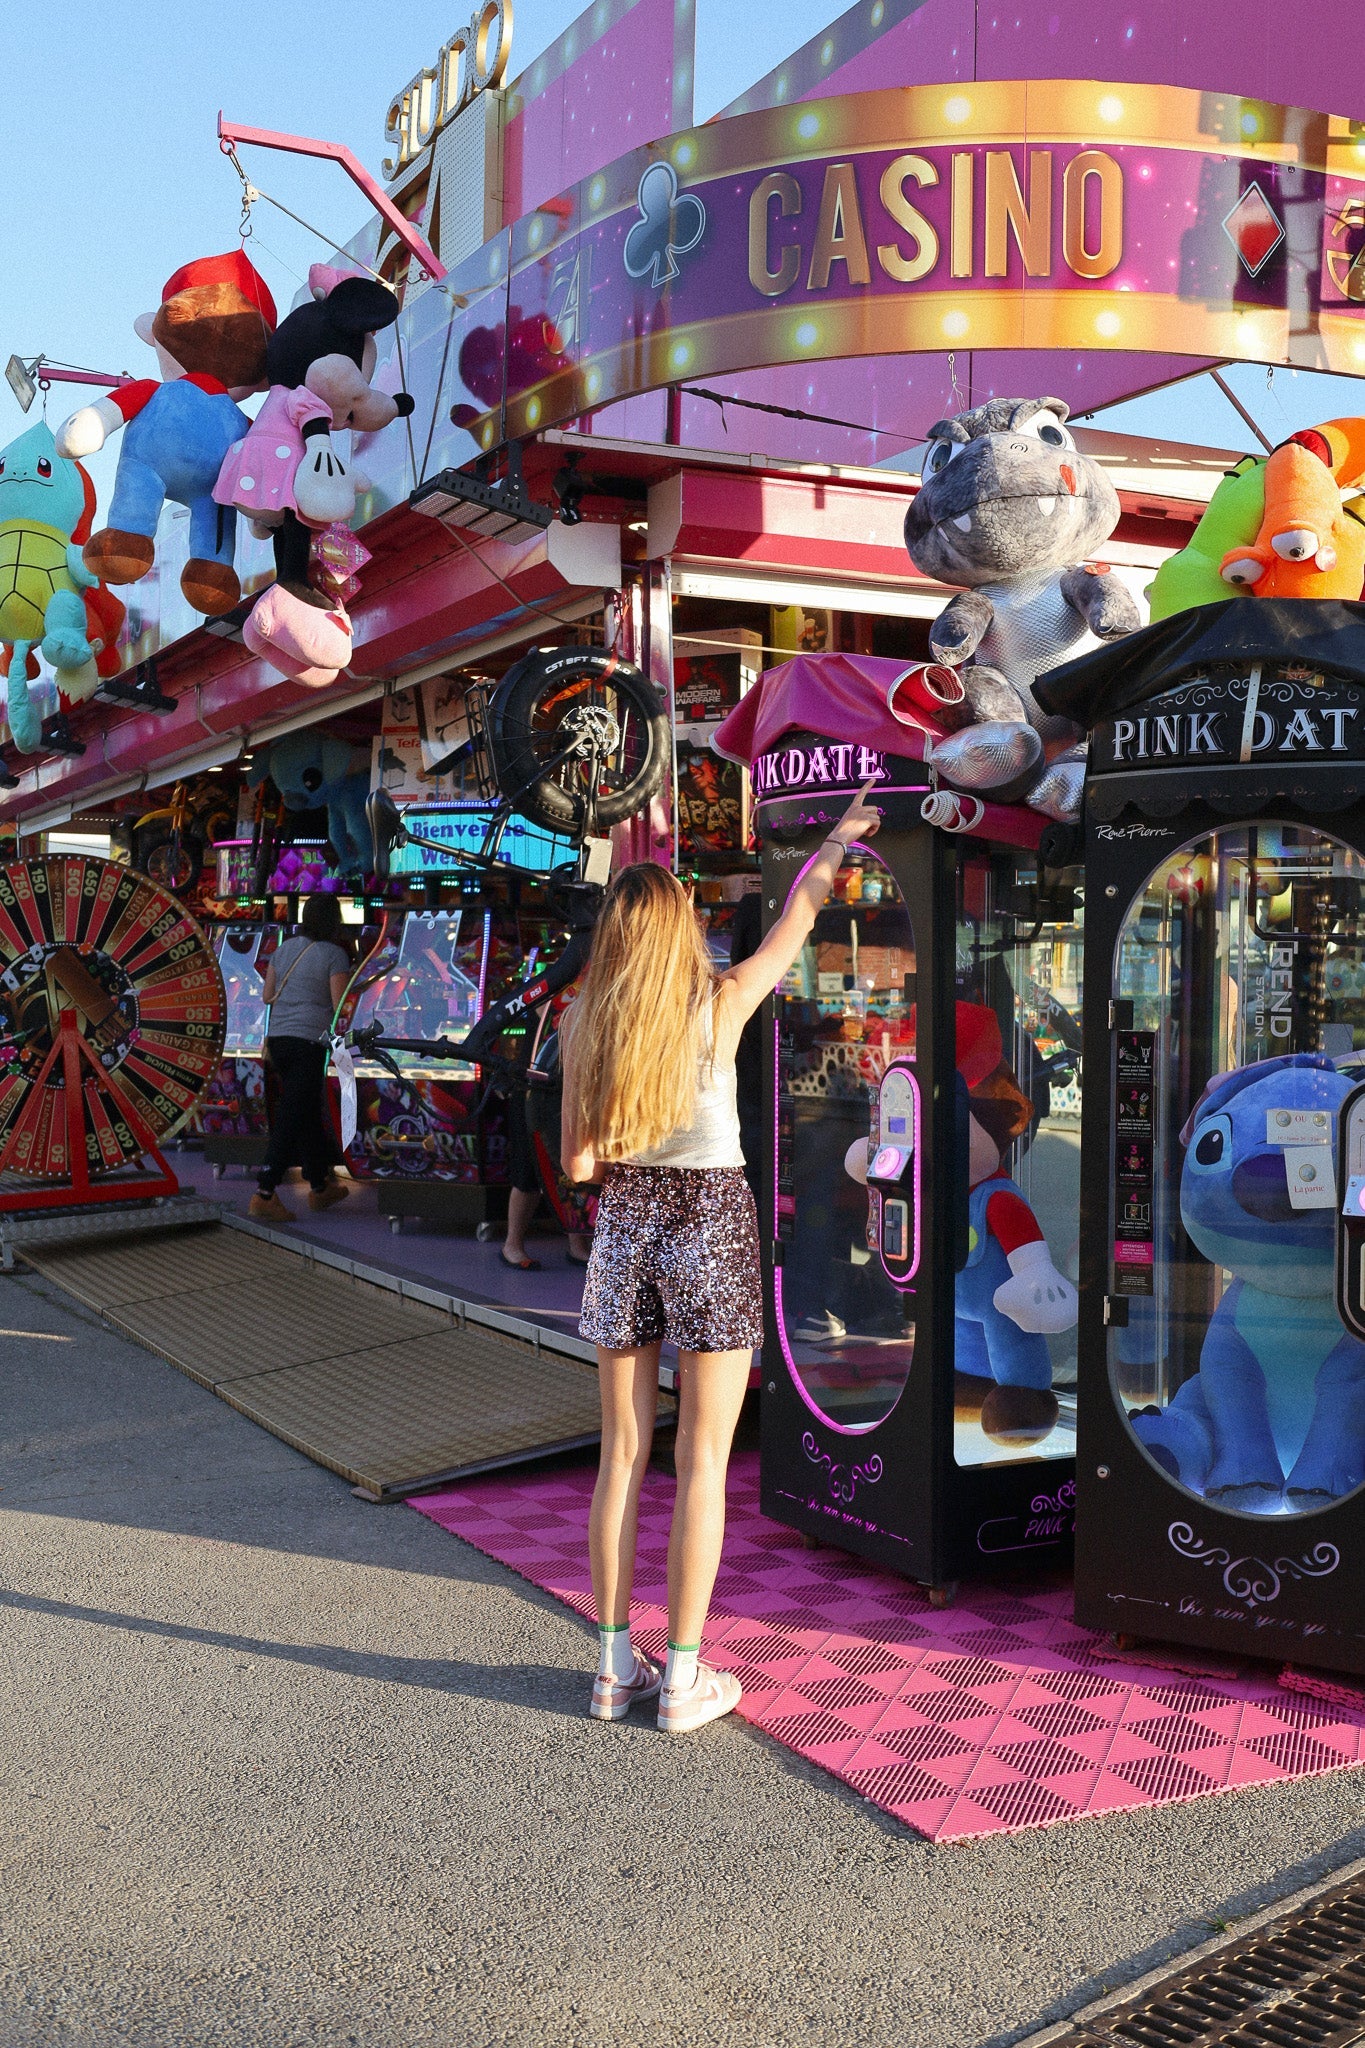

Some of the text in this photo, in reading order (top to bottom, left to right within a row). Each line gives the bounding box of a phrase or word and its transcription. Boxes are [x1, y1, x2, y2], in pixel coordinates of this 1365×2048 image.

[748, 150, 1123, 297] CASINO
[544, 660, 564, 674] CST
[566, 656, 589, 665] BFT
[676, 689, 721, 699] MODERN
[676, 696, 721, 705] WARFARE
[396, 738, 421, 748] Tefa
[1112, 708, 1365, 761] PINK DAT
[784, 744, 887, 785] DATE
[412, 821, 525, 840] Bienvee
[1125, 823, 1175, 838] Pierre
[13, 872, 31, 900] 750
[31, 868, 47, 894] 150
[67, 868, 80, 897] 500
[84, 870, 98, 897] 650
[99, 874, 117, 902] 850
[118, 881, 133, 900] 50
[140, 902, 162, 928] 400
[151, 913, 176, 937] 800
[161, 925, 185, 947] 600
[169, 940, 195, 960] 400
[181, 972, 209, 989] 300
[186, 1007, 212, 1020] 550
[505, 994, 526, 1015] TX
[1254, 976, 1265, 1037] STATION
[186, 1024, 213, 1038] 200
[154, 1034, 191, 1050] GAINS
[177, 1053, 204, 1070] 450
[163, 1081, 189, 1103] 850
[1131, 1090, 1138, 1100] 2
[153, 1094, 178, 1118] 350
[15, 1131, 33, 1159] 650
[100, 1127, 118, 1156] 800
[114, 1122, 134, 1148] 600
[51, 1144, 64, 1164] 50
[85, 1133, 100, 1160] 500
[1130, 1145, 1138, 1155] 3
[1130, 1193, 1138, 1203] 4
[1024, 1516, 1067, 1539] PINK
[662, 1686, 675, 1697] NIKE
